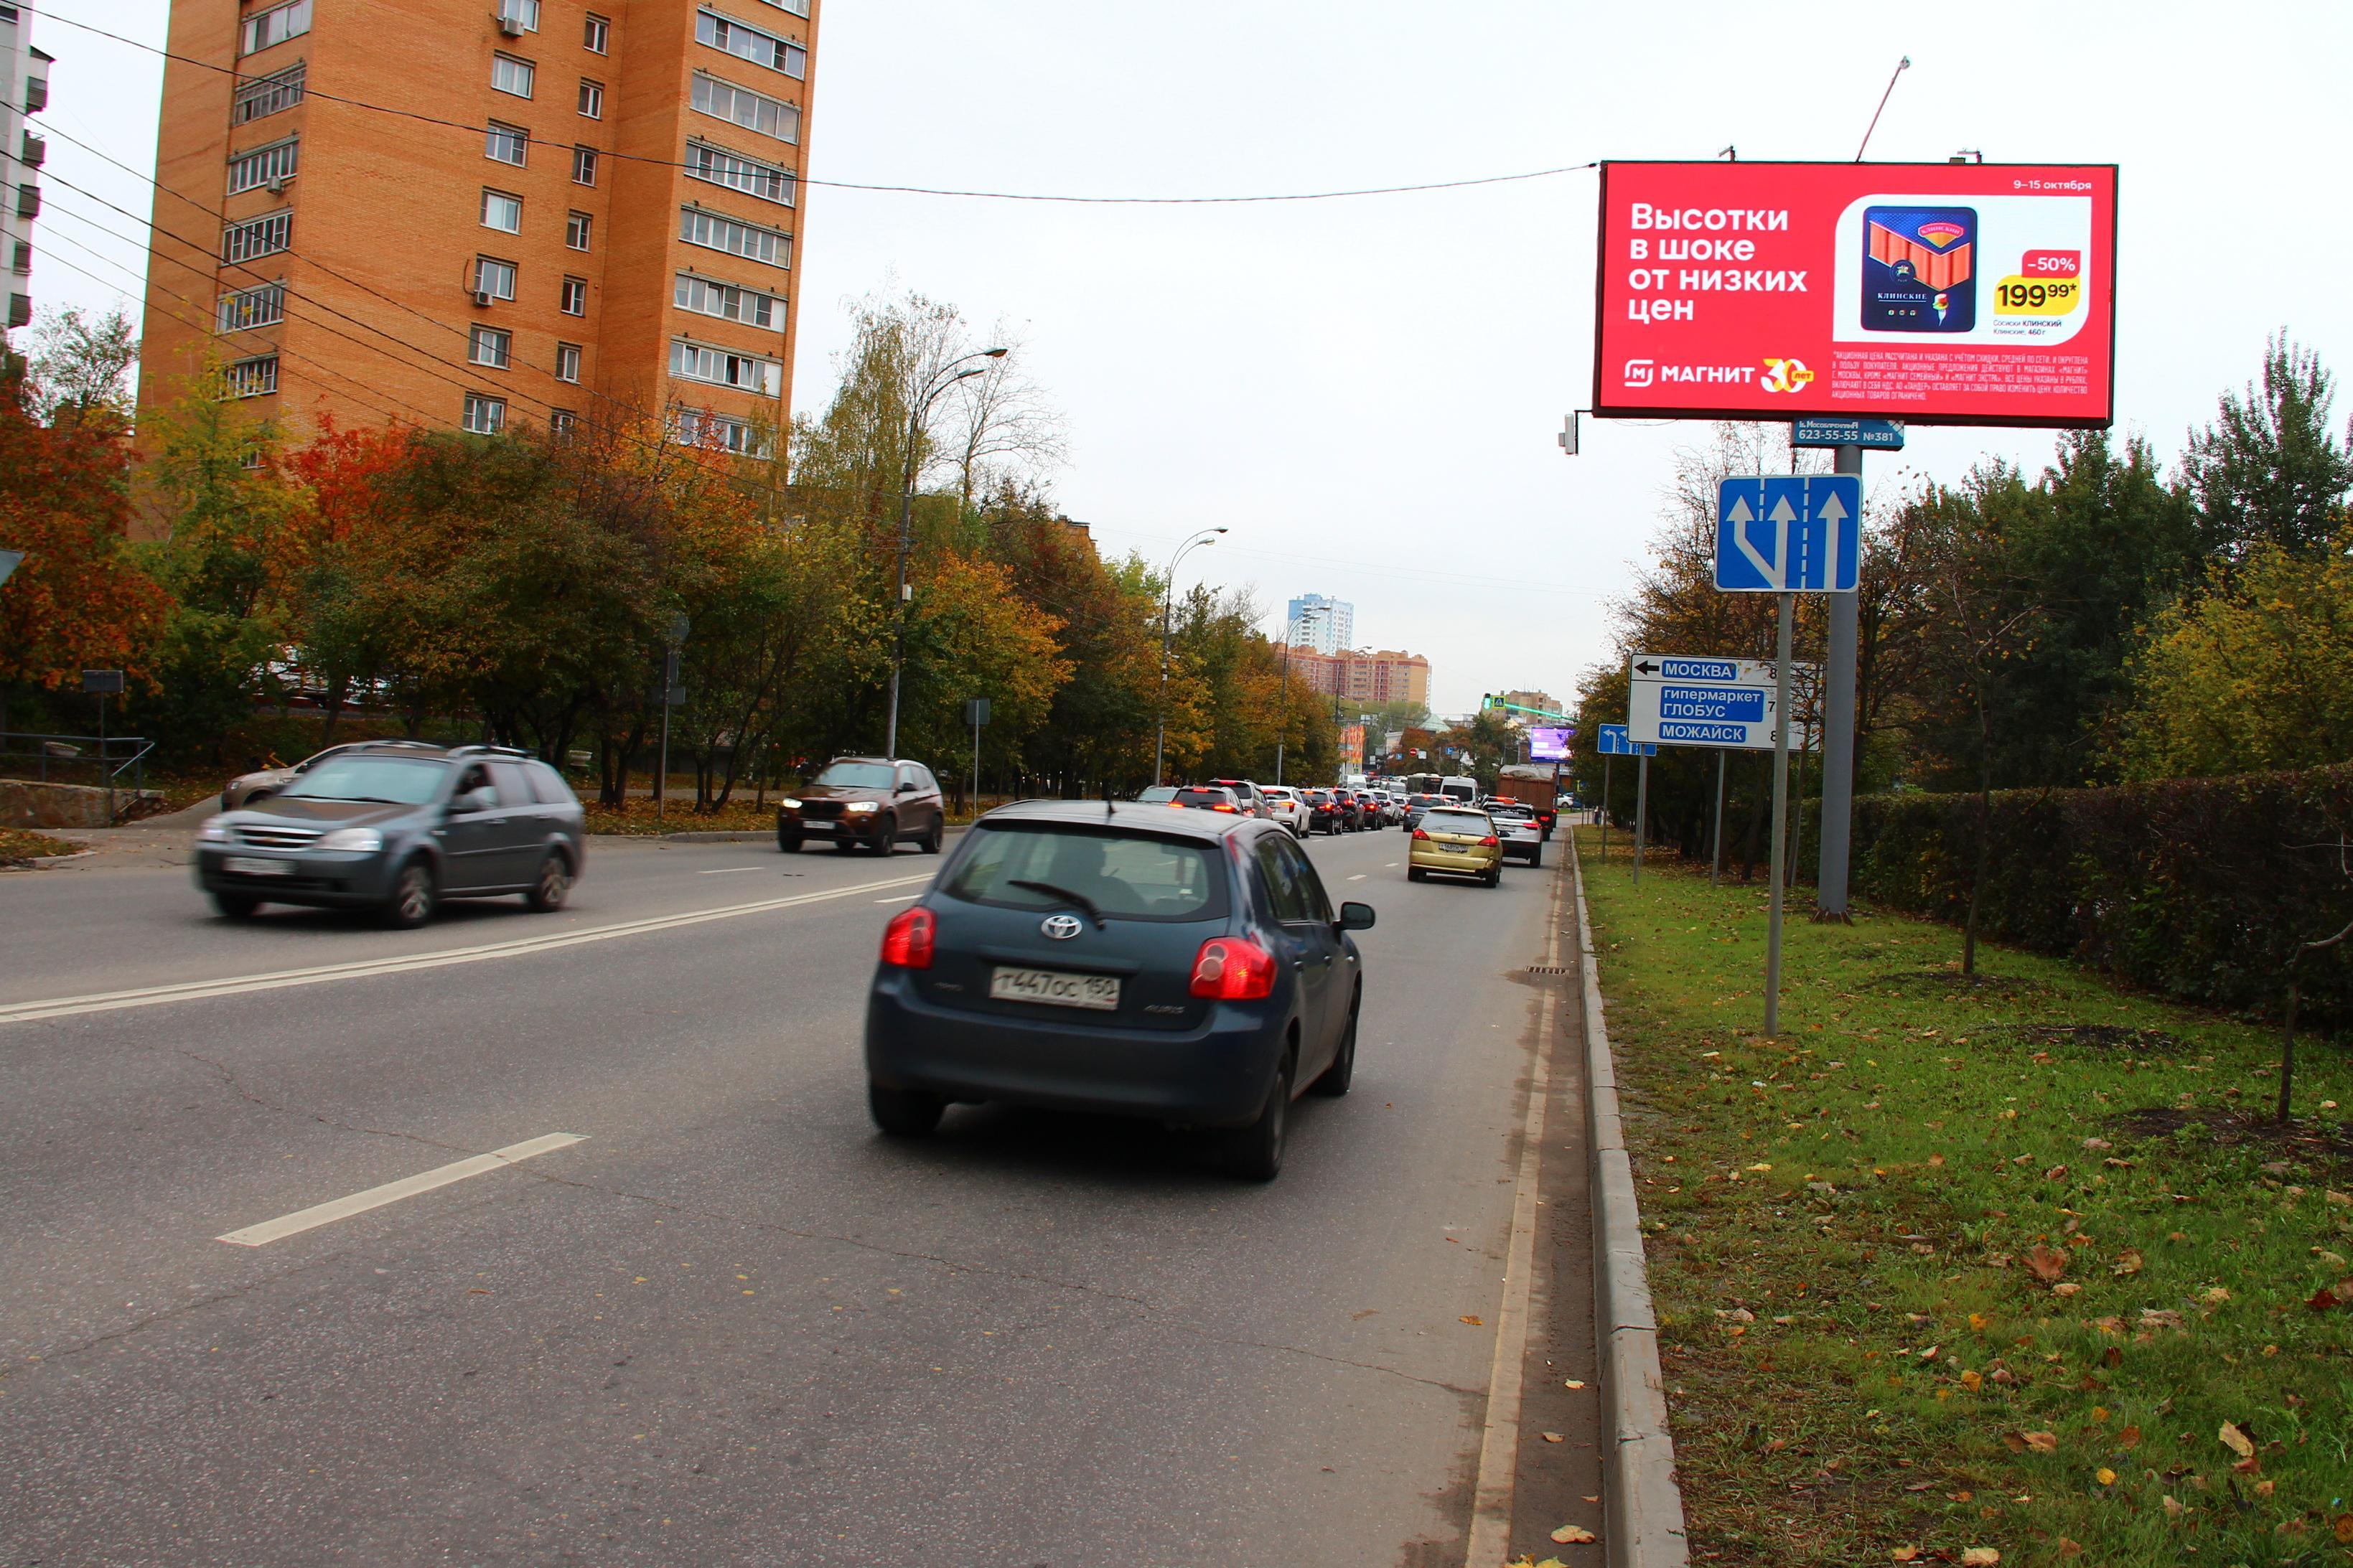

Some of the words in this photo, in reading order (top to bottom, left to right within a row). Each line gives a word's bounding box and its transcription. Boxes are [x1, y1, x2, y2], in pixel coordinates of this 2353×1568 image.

[2043, 179, 2092, 192] октября
[1631, 202, 1788, 231] Высотки
[1630, 238, 1649, 260] в
[1659, 239, 1756, 260] шоке
[1628, 268, 1670, 290] от
[1679, 269, 1808, 292] низких
[1628, 299, 1694, 324] цен
[1869, 352, 1884, 360] ЦЕНА
[1884, 352, 1918, 360] РАССЧИТАНА
[1924, 352, 1948, 361] УКАЗАНА
[2001, 354, 2026, 363] СРЕДНЕЙ
[2027, 355, 2035, 363] ПО
[2057, 356, 2089, 365] ОКРУГЛЕНА
[1660, 365, 1756, 383] МАГНИТ
[1793, 371, 1812, 380] лет
[1839, 361, 1860, 370] ПОЛЬЗУ
[1901, 362, 1935, 371] АКЦИОННЫЕ
[1939, 363, 1978, 372] ПРЕДЛОЖЕНИЯ
[1981, 363, 2013, 373] ДЕЙСТВУЮТ
[2016, 375, 2033, 383] ЦЕНЫ
[2034, 375, 2059, 384] УКАЗАНЫ
[1832, 380, 1862, 389] ВКЛЮЧАЮТ
[1868, 381, 1881, 390] СЕБЯ
[1895, 382, 1903, 390] АО
[1932, 382, 1962, 391] ОСТАВЛЯЕТ
[1970, 383, 1988, 392] СОБОЙ
[1989, 384, 2006, 393] ПРАВО
[2007, 385, 2036, 393] ИЗМЕНИТЬ
[2053, 385, 2087, 394] КОЛИЧЕСТВО
[1832, 390, 1865, 400] АКЦИОННЫХ
[1866, 391, 1890, 400] ТОВАРОВ
[1798, 429, 1858, 441] 623-55-55
[1863, 432, 1894, 442] №381
[1665, 663, 1732, 678] МОСКВА
[1664, 689, 1761, 703] гипермаркет
[1663, 703, 1726, 718] ГЛОБУС
[1662, 724, 1743, 741] МОЖАЙСК
